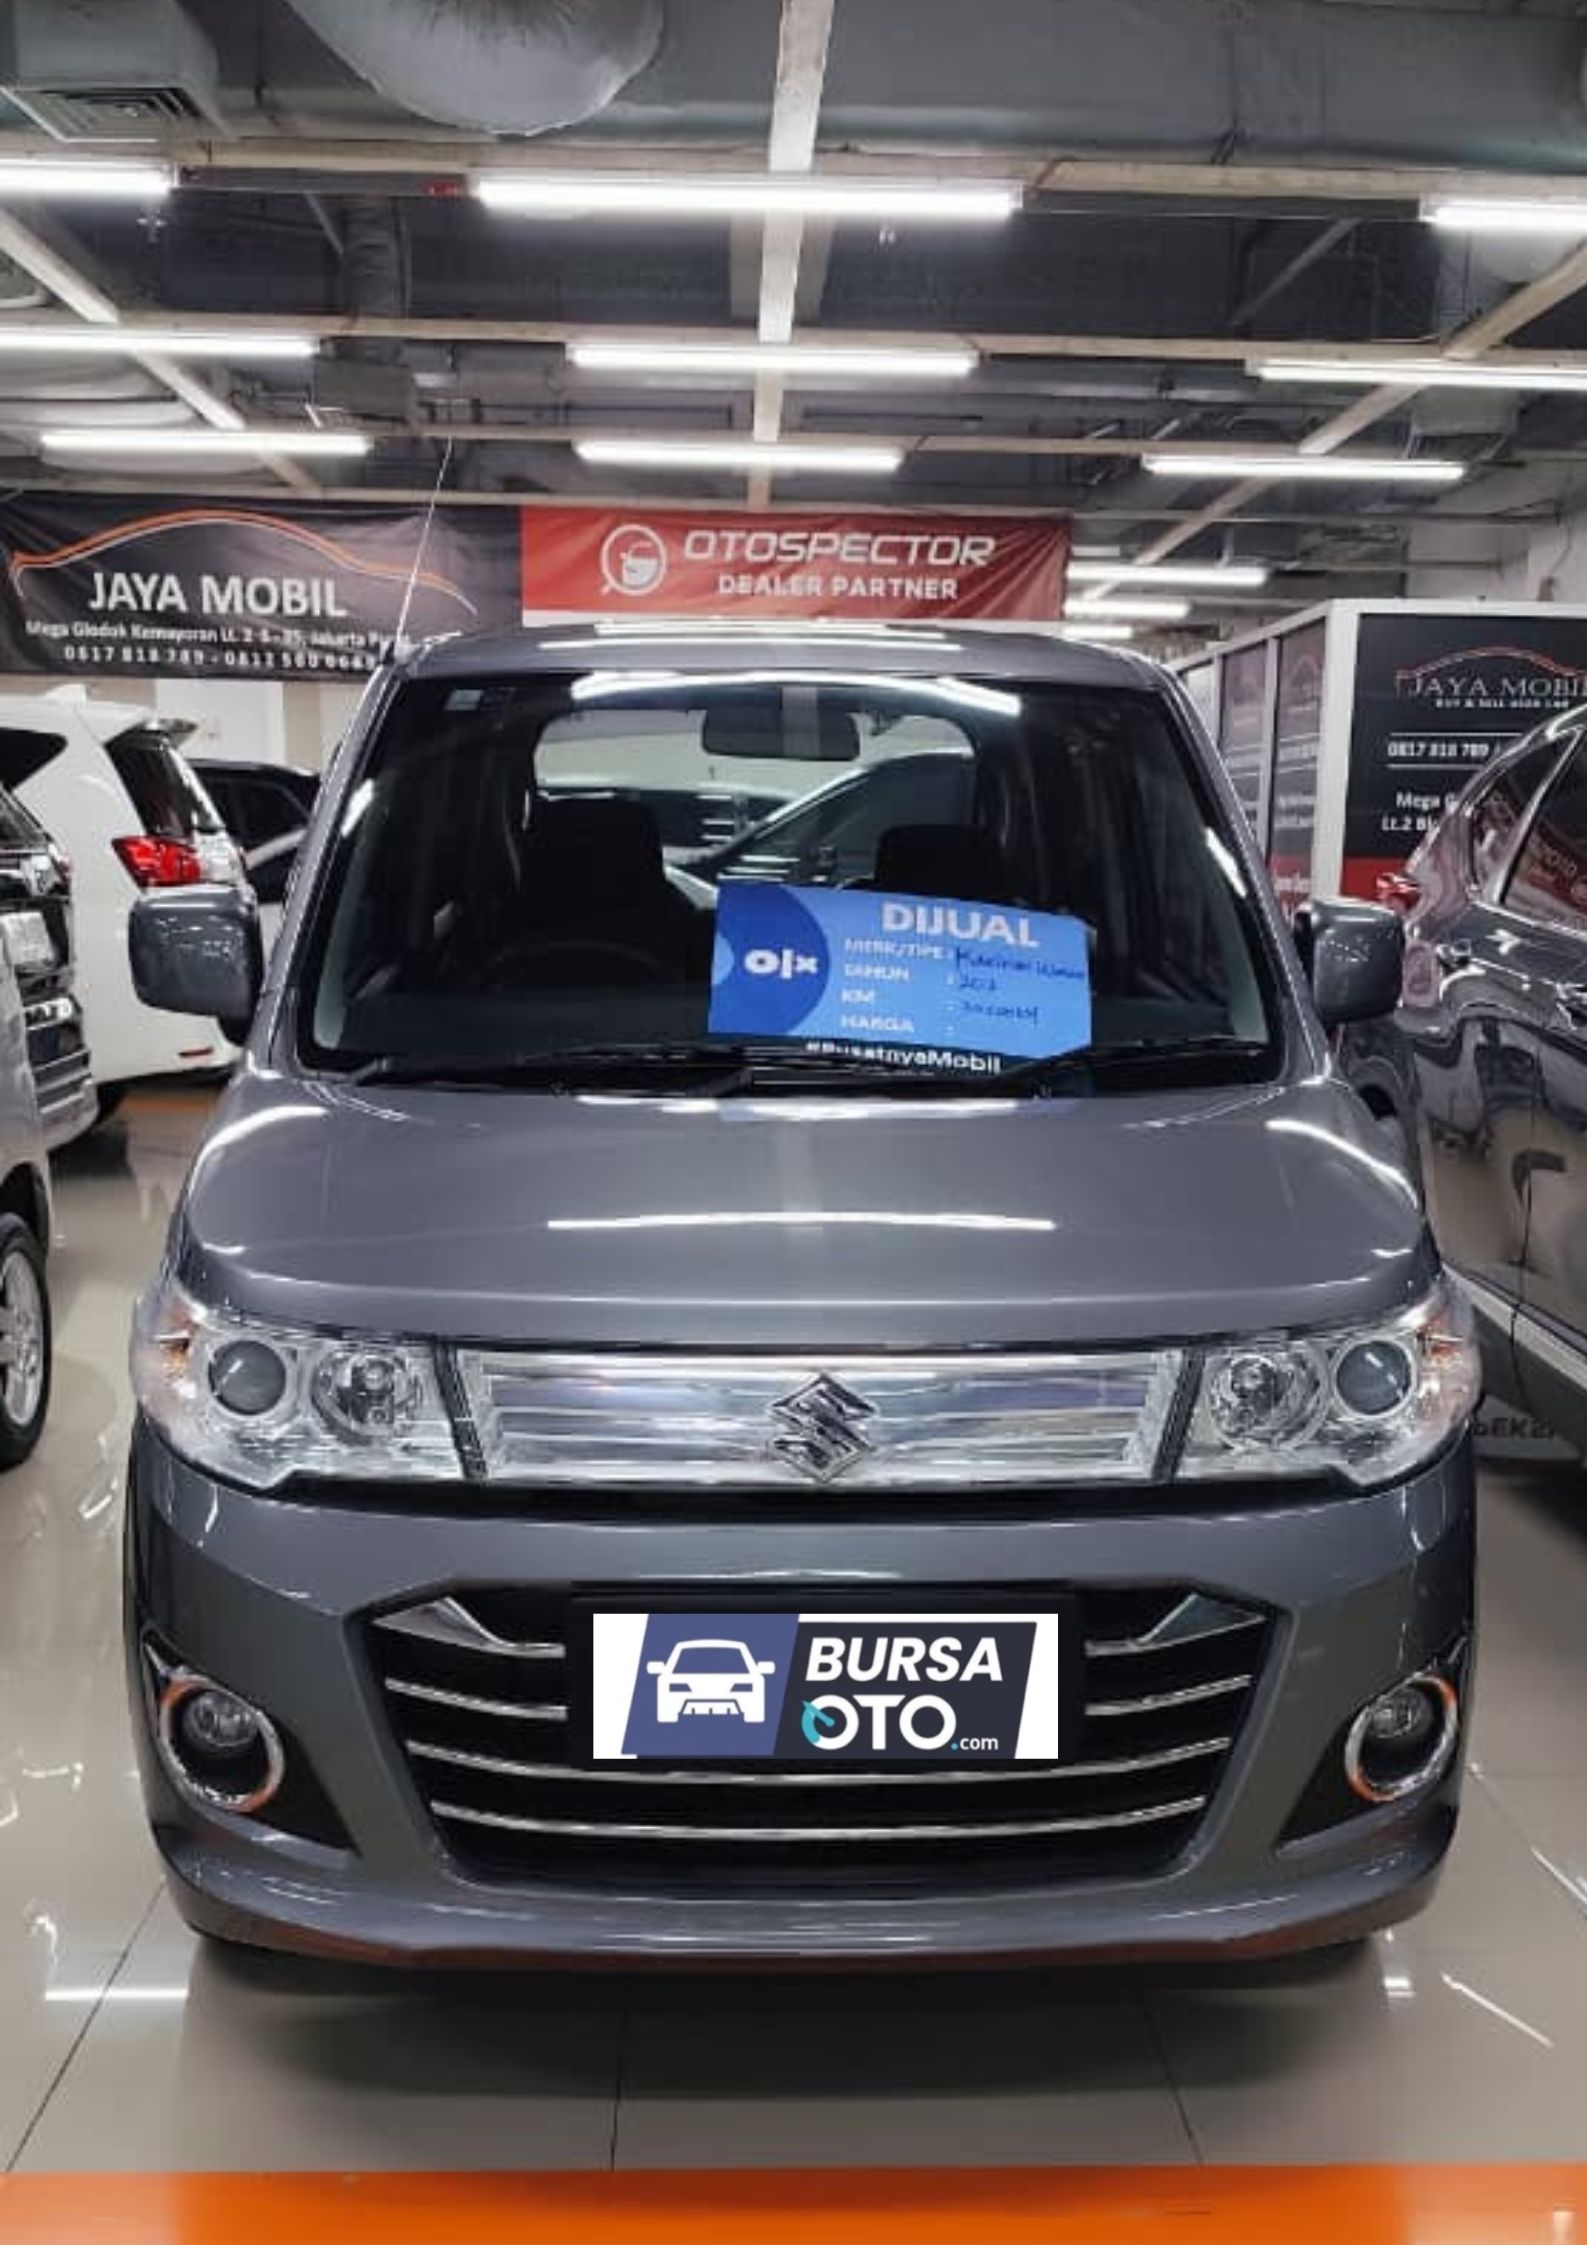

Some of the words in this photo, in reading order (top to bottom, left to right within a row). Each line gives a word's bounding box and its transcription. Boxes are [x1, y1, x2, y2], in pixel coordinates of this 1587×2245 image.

[683, 531, 996, 567] OTOSPECTOR
[88, 573, 188, 612] JAYA
[201, 575, 349, 617] MOBIL
[718, 574, 822, 597] DEALER
[832, 577, 958, 600] PARTNER
[1408, 677, 1489, 697] JAYA
[1395, 791, 1441, 812] Mega
[881, 901, 1041, 948] DIJUAL
[743, 948, 819, 980] olx
[841, 988, 876, 1004] KM
[841, 1015, 915, 1033] HARGA
